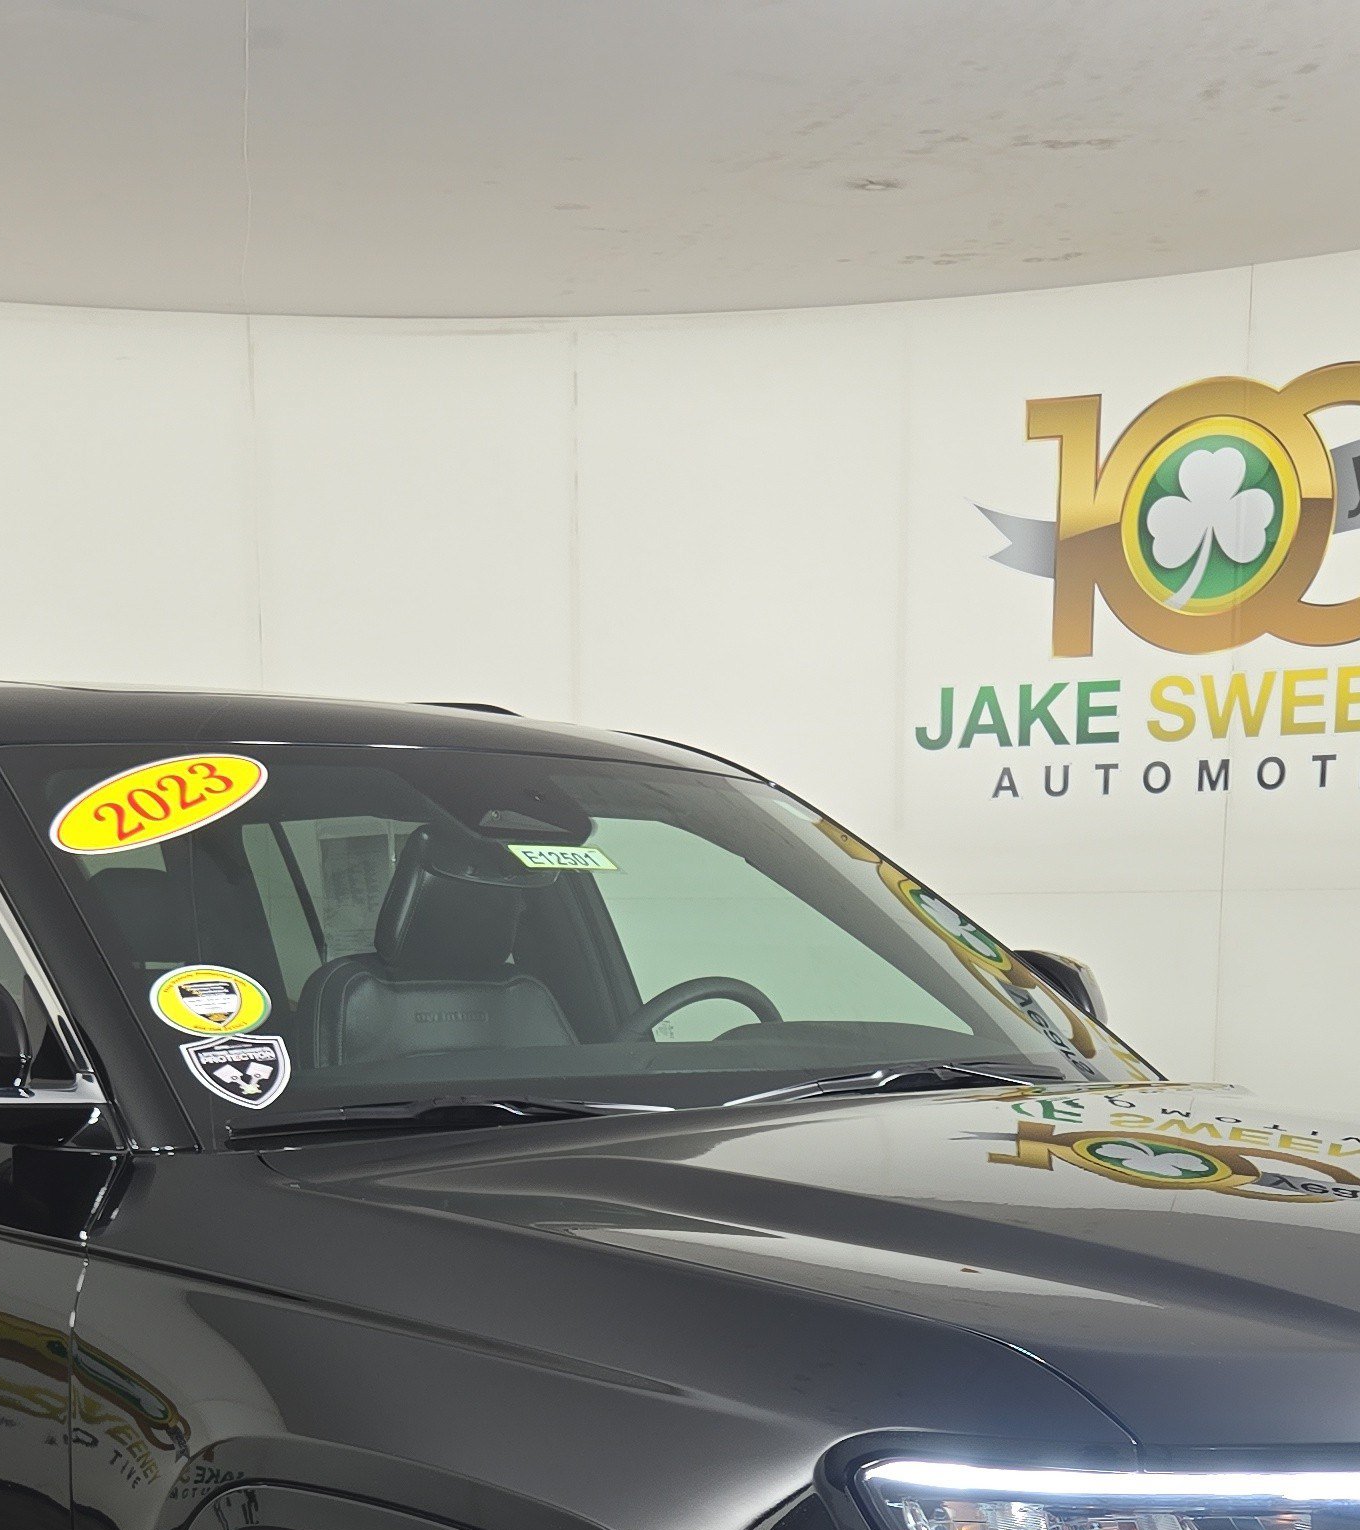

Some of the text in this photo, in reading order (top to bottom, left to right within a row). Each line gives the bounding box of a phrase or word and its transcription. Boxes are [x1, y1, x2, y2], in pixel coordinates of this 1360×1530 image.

[915, 679, 1121, 751] JAKE
[93, 762, 235, 842] 2023
[521, 850, 600, 867] E12501
